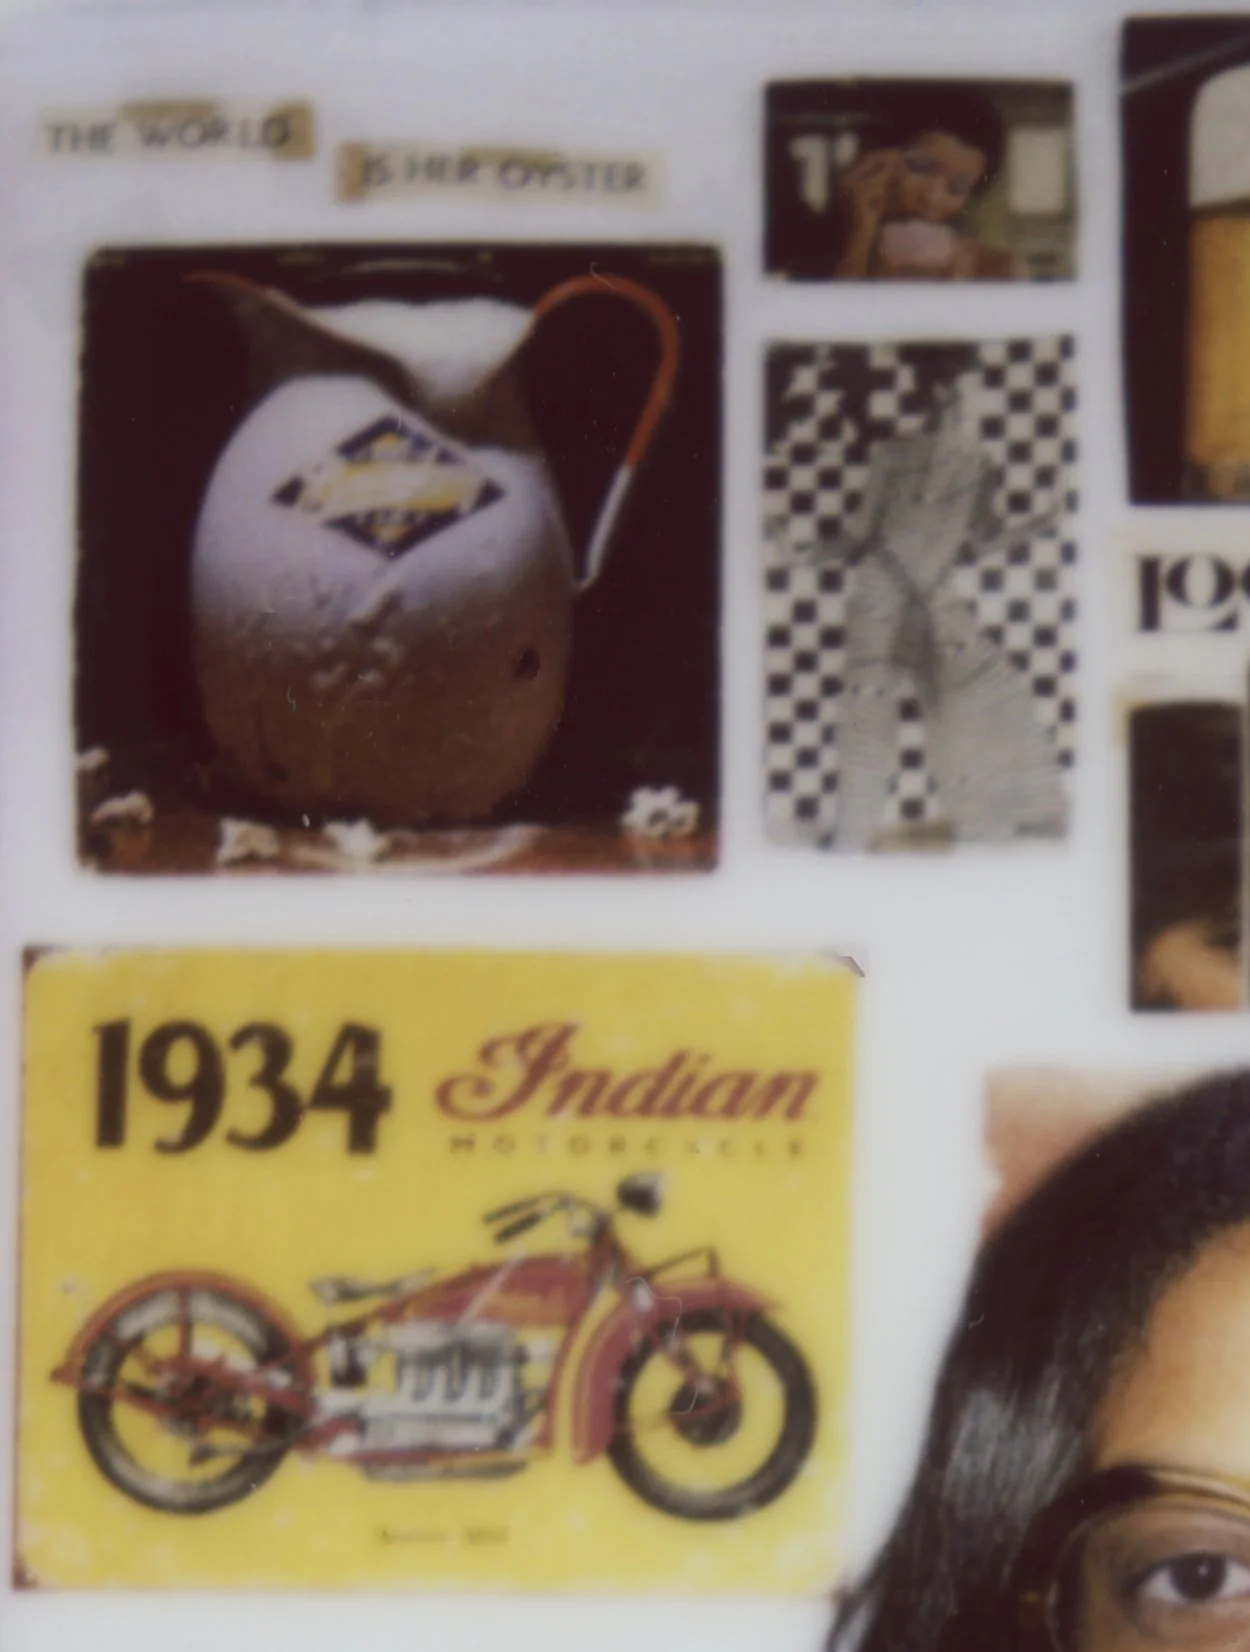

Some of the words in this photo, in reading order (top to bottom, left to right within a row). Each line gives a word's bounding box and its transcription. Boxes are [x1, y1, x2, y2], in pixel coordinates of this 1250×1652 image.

[45, 116, 112, 151] THE
[136, 108, 293, 150] WORLD
[404, 150, 479, 187] HER
[498, 156, 648, 192] OYSTER
[93, 1016, 394, 1157] 1934
[433, 1020, 820, 1122] Indian
